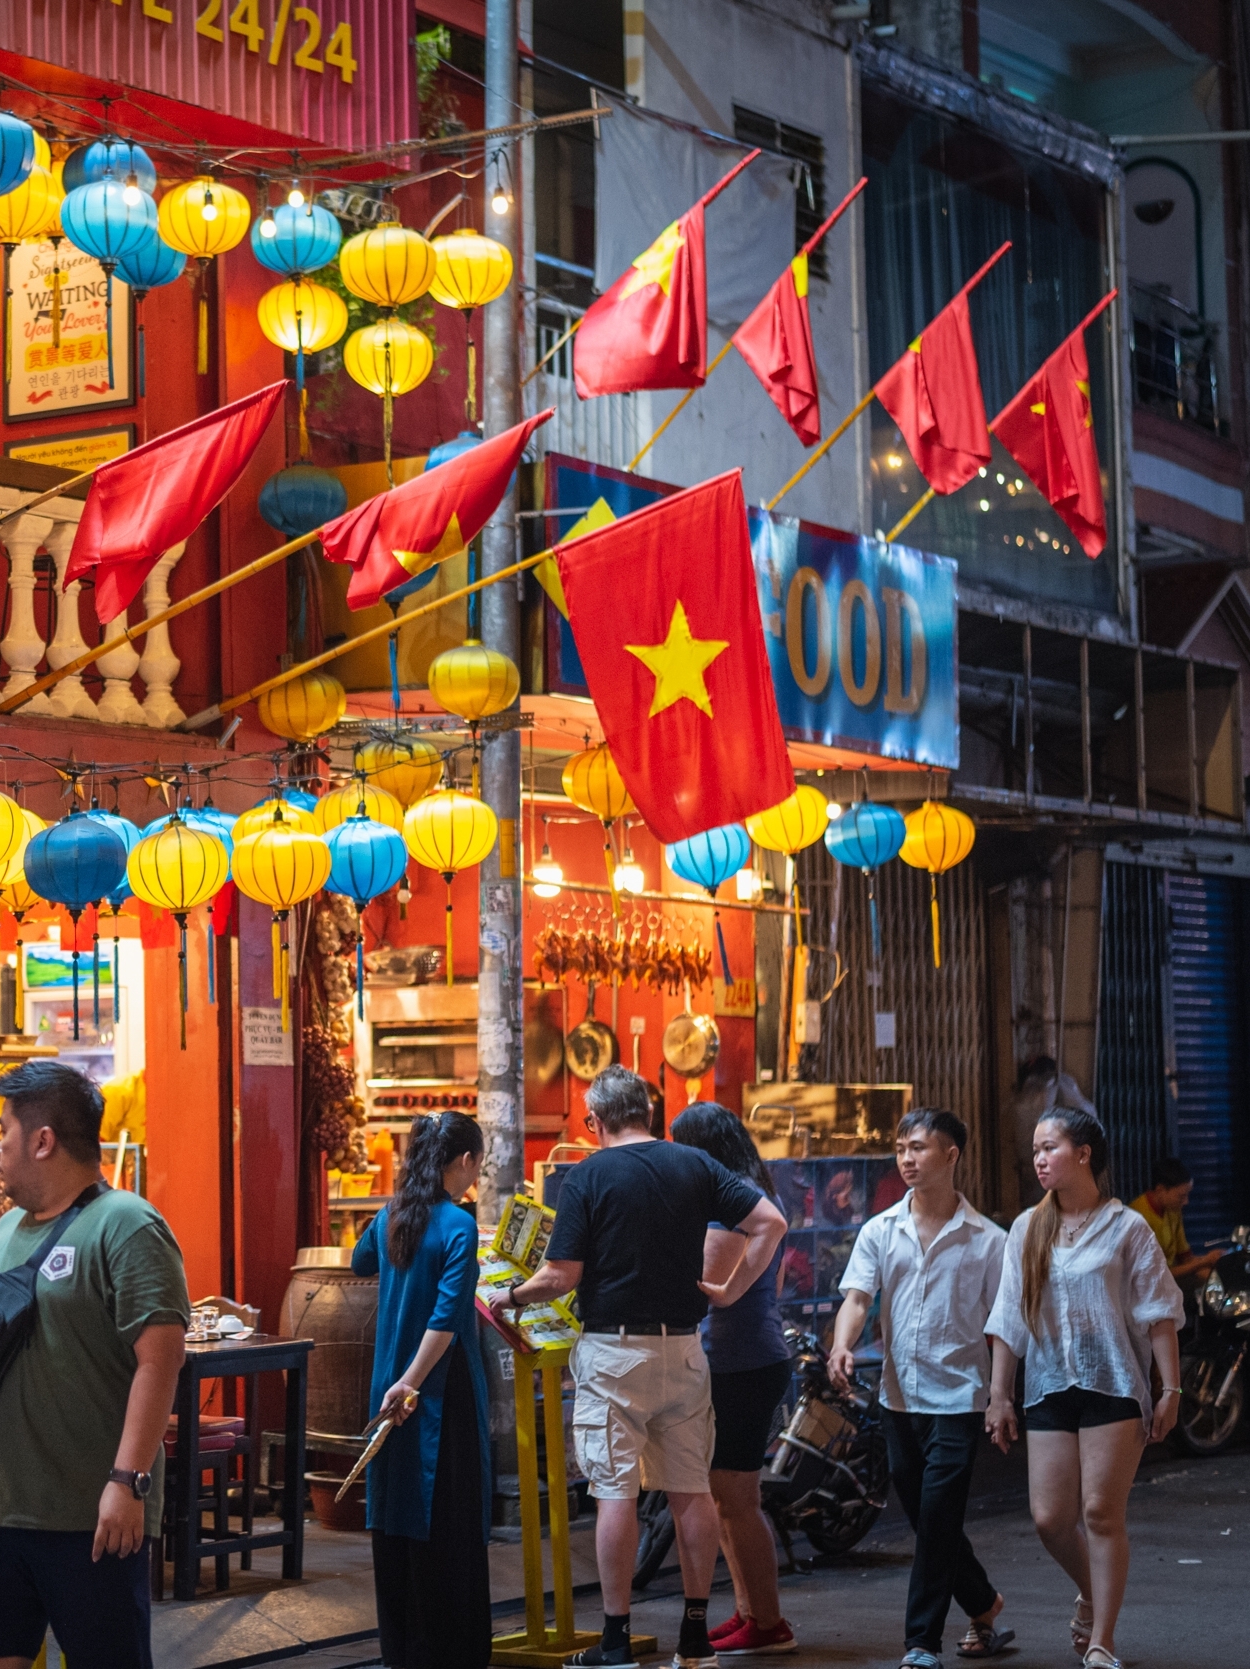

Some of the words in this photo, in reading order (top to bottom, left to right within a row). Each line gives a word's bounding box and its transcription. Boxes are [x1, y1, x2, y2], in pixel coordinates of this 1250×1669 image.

[195, 0, 357, 84] 24/24
[27, 280, 108, 311] WAITING
[23, 321, 54, 342] You
